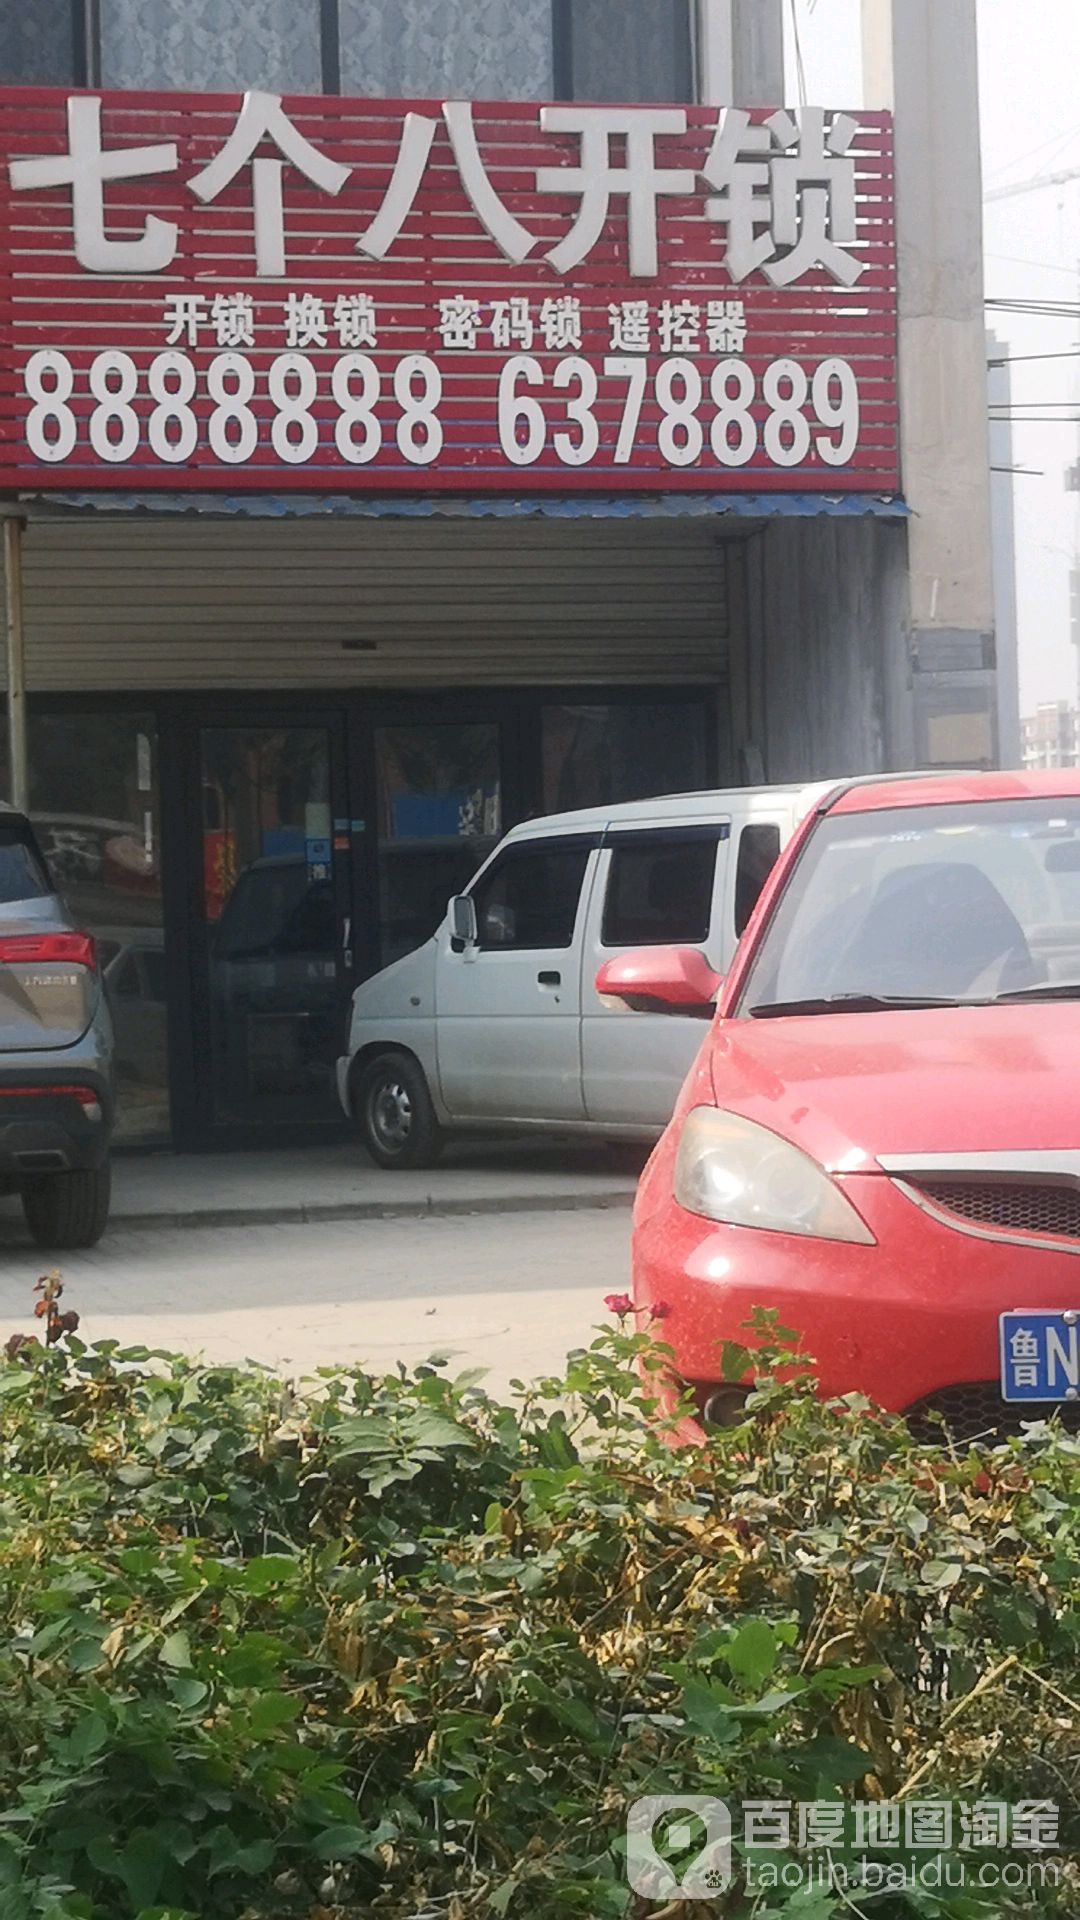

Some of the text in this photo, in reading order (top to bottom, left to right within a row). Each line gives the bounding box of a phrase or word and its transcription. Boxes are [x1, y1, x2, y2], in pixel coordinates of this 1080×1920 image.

[8, 91, 865, 288] 七个八开锁
[163, 292, 748, 353] 开锁 换锁 密码锁 遥控器
[24, 350, 860, 467] 8888888 6378889
[1009, 1326, 1079, 1388] 鲁N
